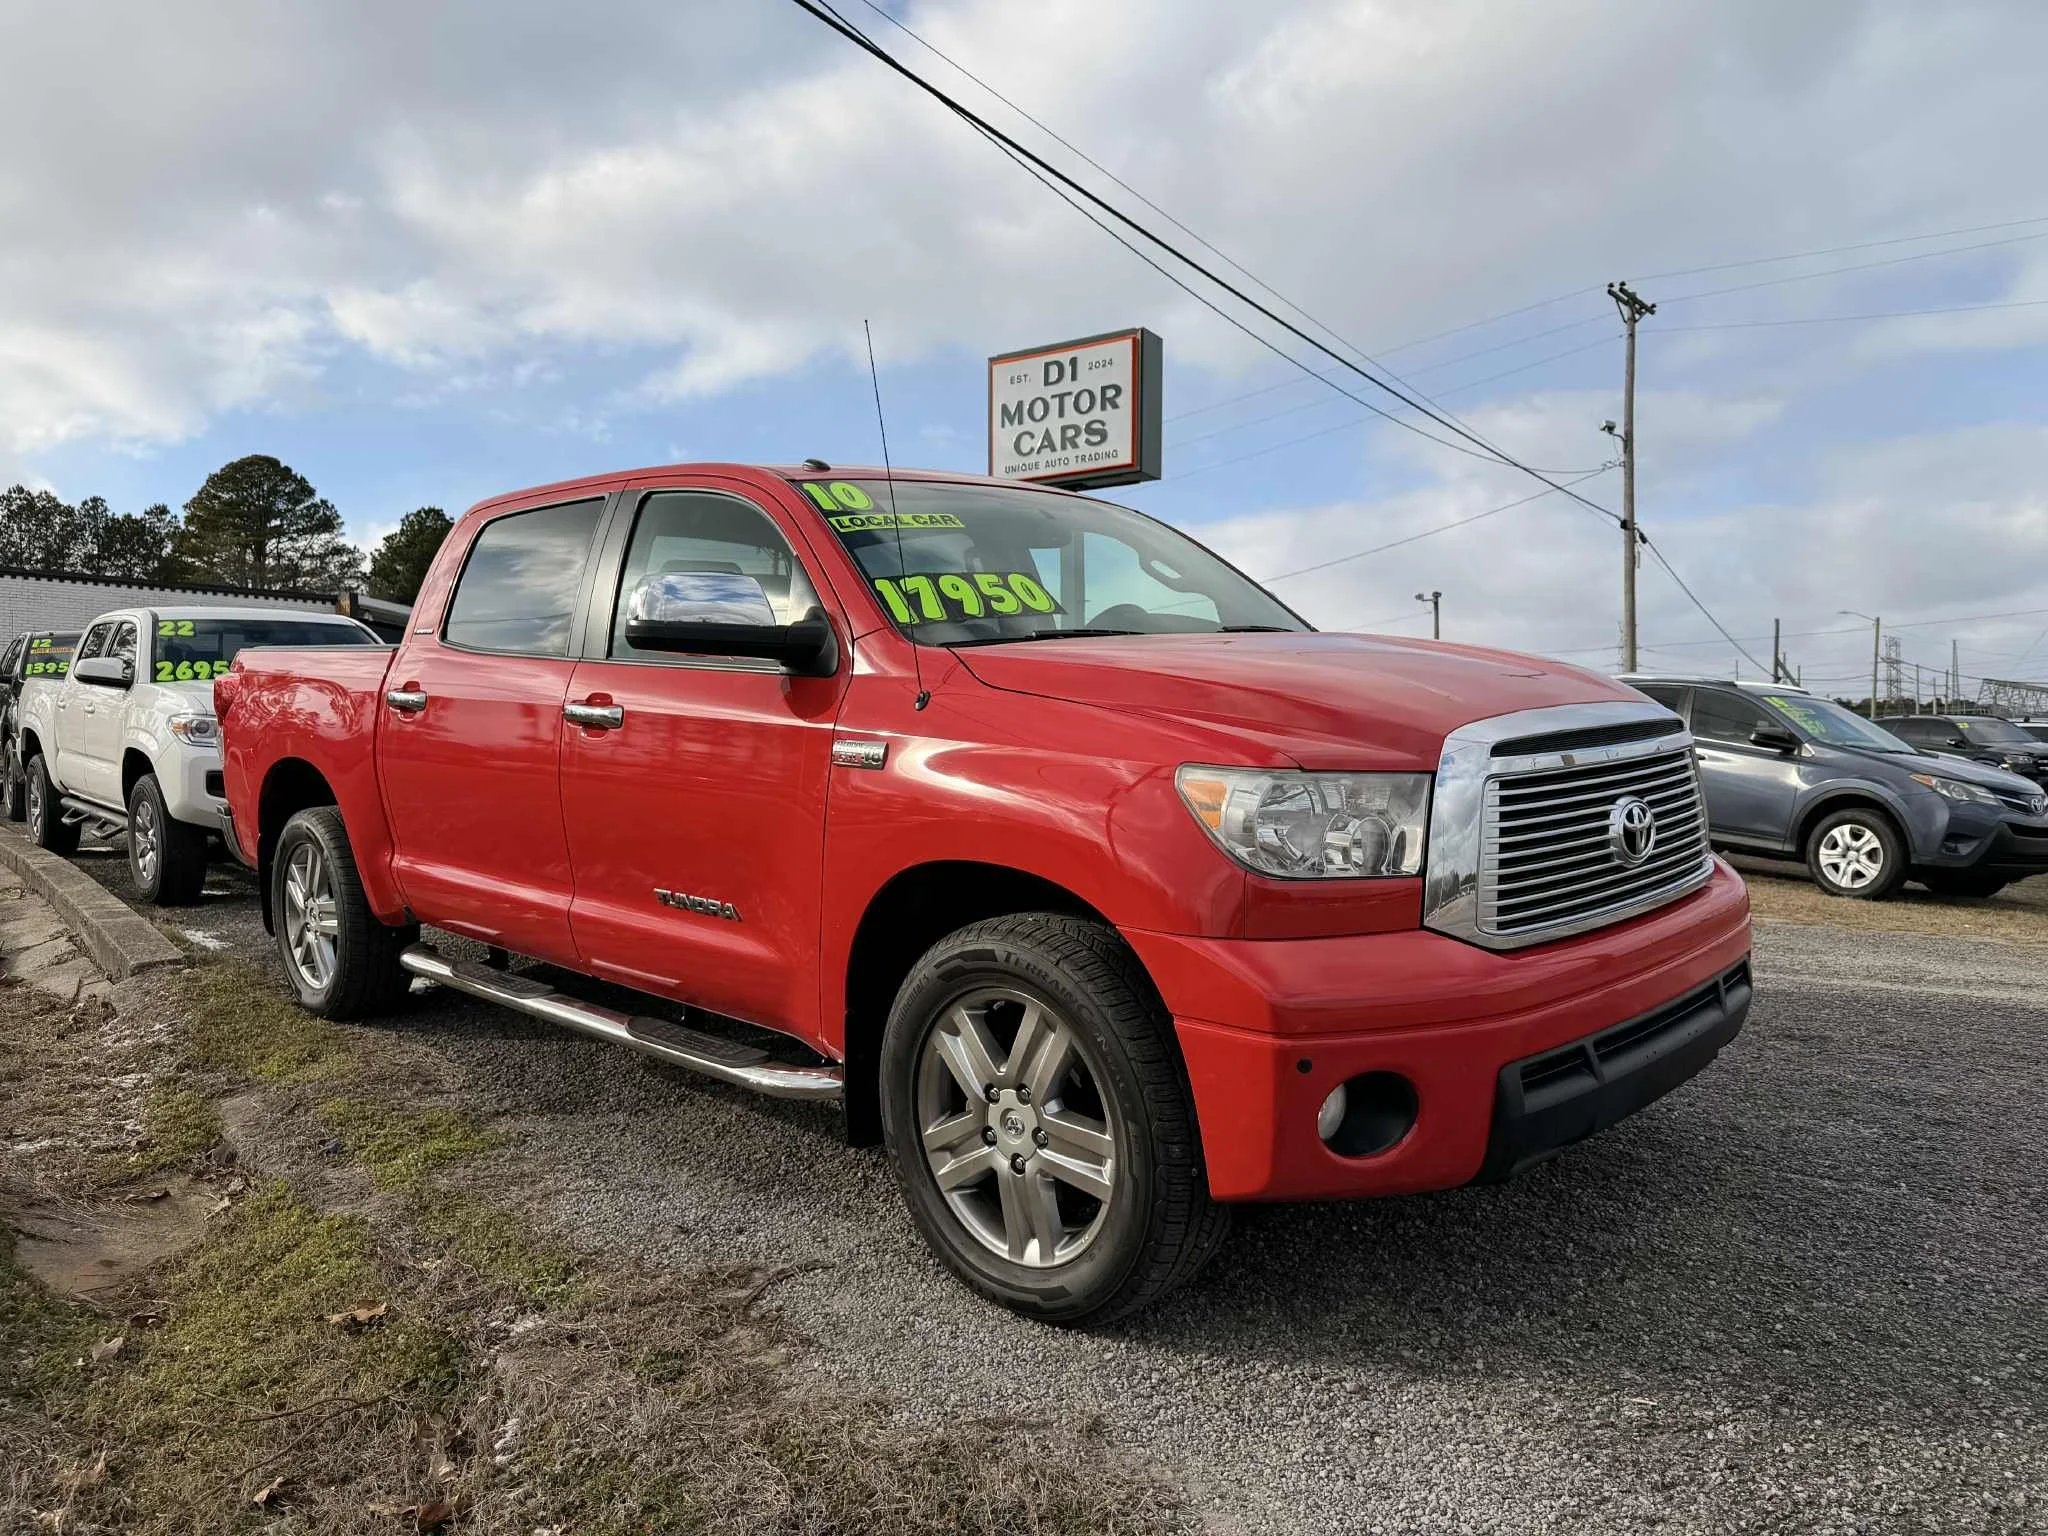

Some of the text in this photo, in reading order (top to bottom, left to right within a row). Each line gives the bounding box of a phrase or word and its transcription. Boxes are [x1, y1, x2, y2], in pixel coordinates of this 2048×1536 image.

[1010, 358, 1114, 385] EST. 2024
[1043, 356, 1078, 386] D1
[1000, 384, 1122, 429] MOTOR
[1013, 419, 1109, 457] CARS
[1004, 449, 1119, 474] UNIQUE AUTO TRADING
[802, 481, 874, 511] 10
[834, 514, 956, 529] LOCAL CAR
[874, 573, 1056, 625] 17950
[32, 639, 52, 648] 12
[159, 620, 195, 637] 22
[653, 888, 743, 922] TUNDRA
